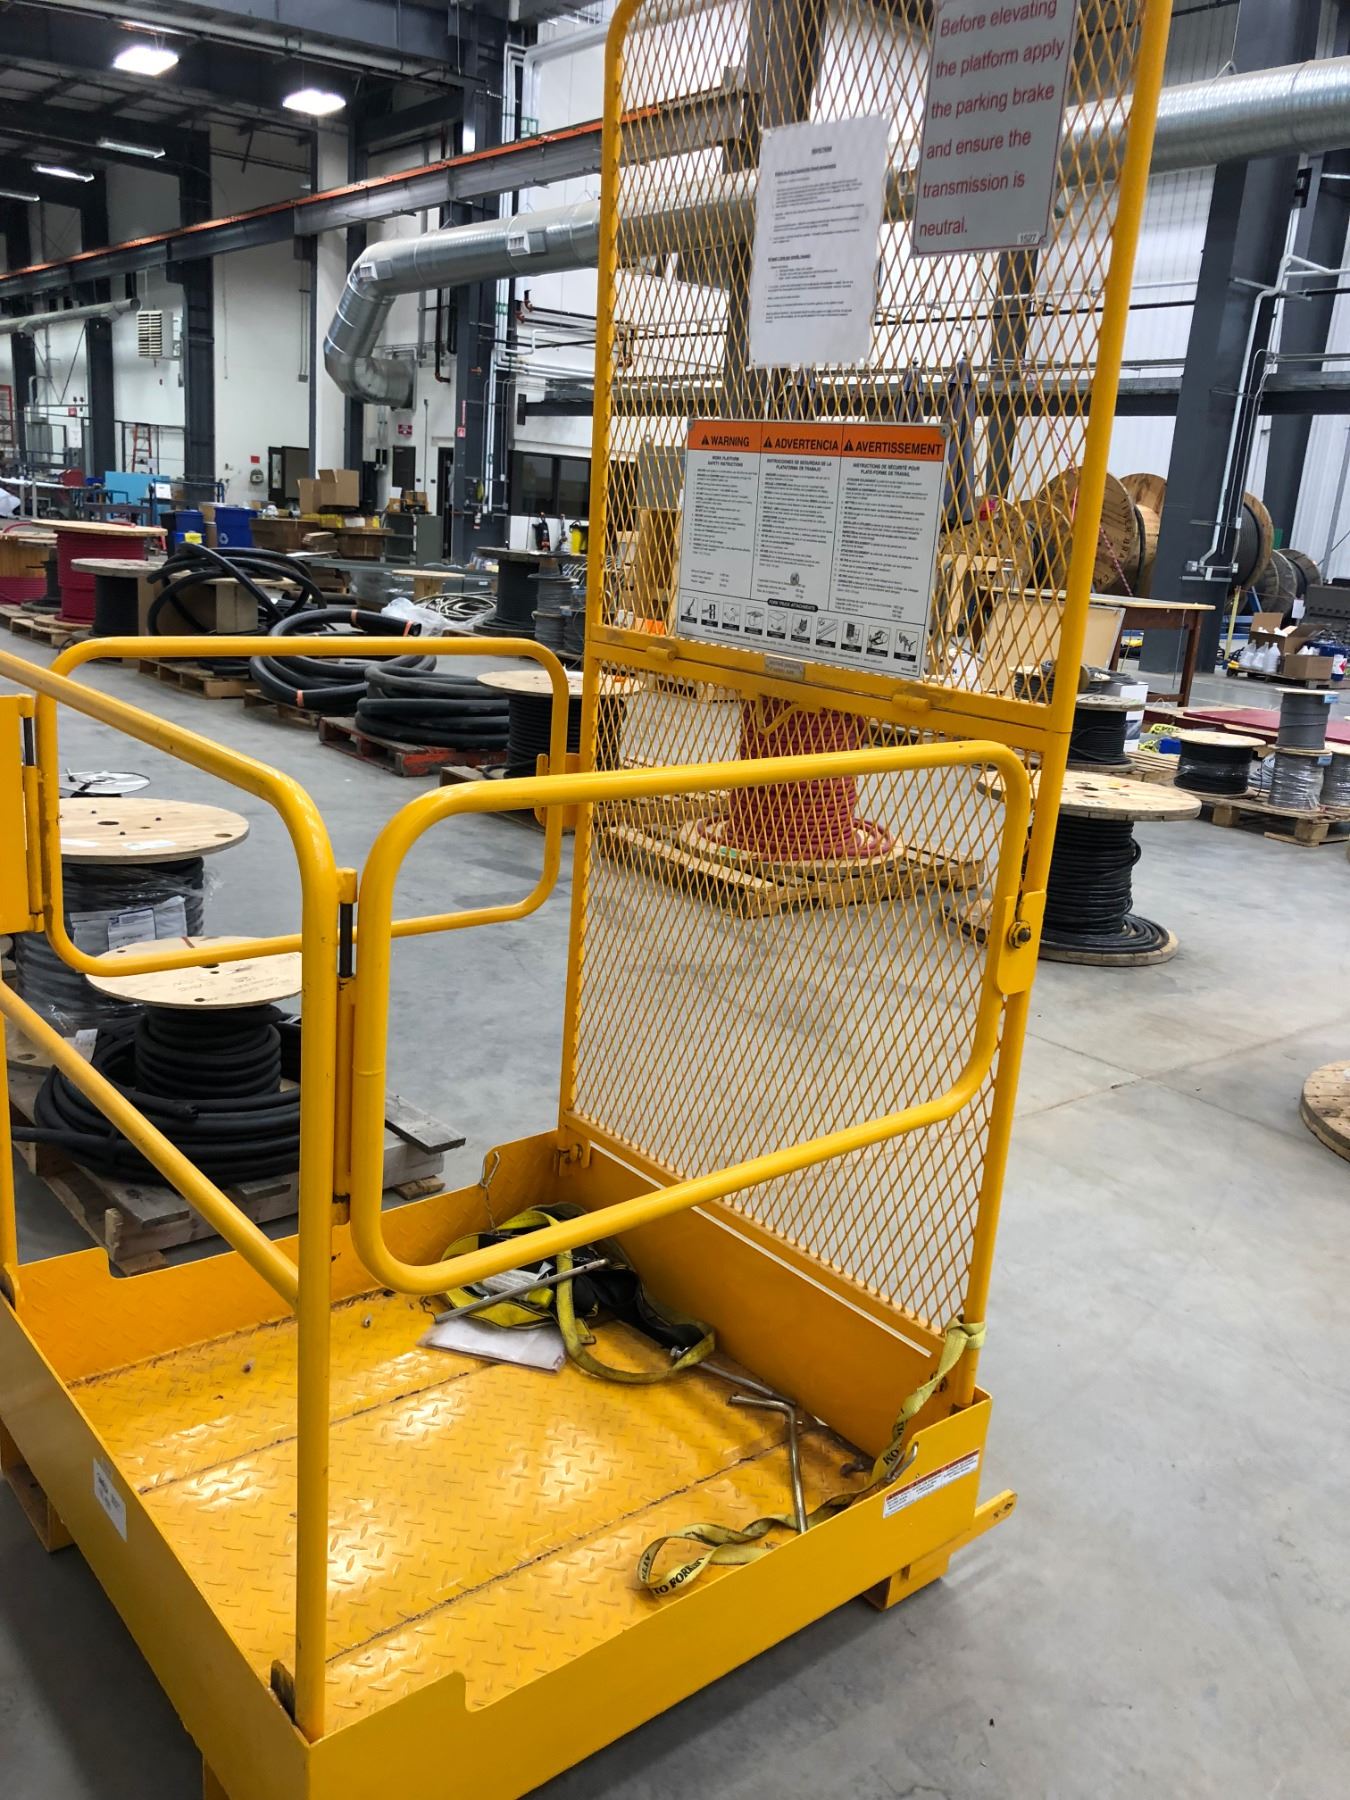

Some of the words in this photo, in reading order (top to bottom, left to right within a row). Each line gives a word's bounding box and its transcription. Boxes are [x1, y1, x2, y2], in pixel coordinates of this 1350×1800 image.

[941, 15, 986, 38] Before
[990, 0, 1057, 27] elevating
[936, 62, 956, 79] the
[961, 49, 1018, 77] platform
[1023, 39, 1065, 63] apply
[932, 102, 951, 120] the
[956, 91, 1008, 119] parking
[1012, 83, 1055, 106] brake
[927, 141, 951, 160] and
[956, 133, 1004, 155] ensure
[1008, 129, 1031, 149] the
[923, 173, 1008, 199] transmission
[1013, 171, 1025, 188] is
[919, 216, 968, 237] neutral.
[711, 436, 750, 447] WARNING
[775, 438, 839, 451] ADVERTENCIA
[857, 441, 943, 456] AVERTISSEMENT
